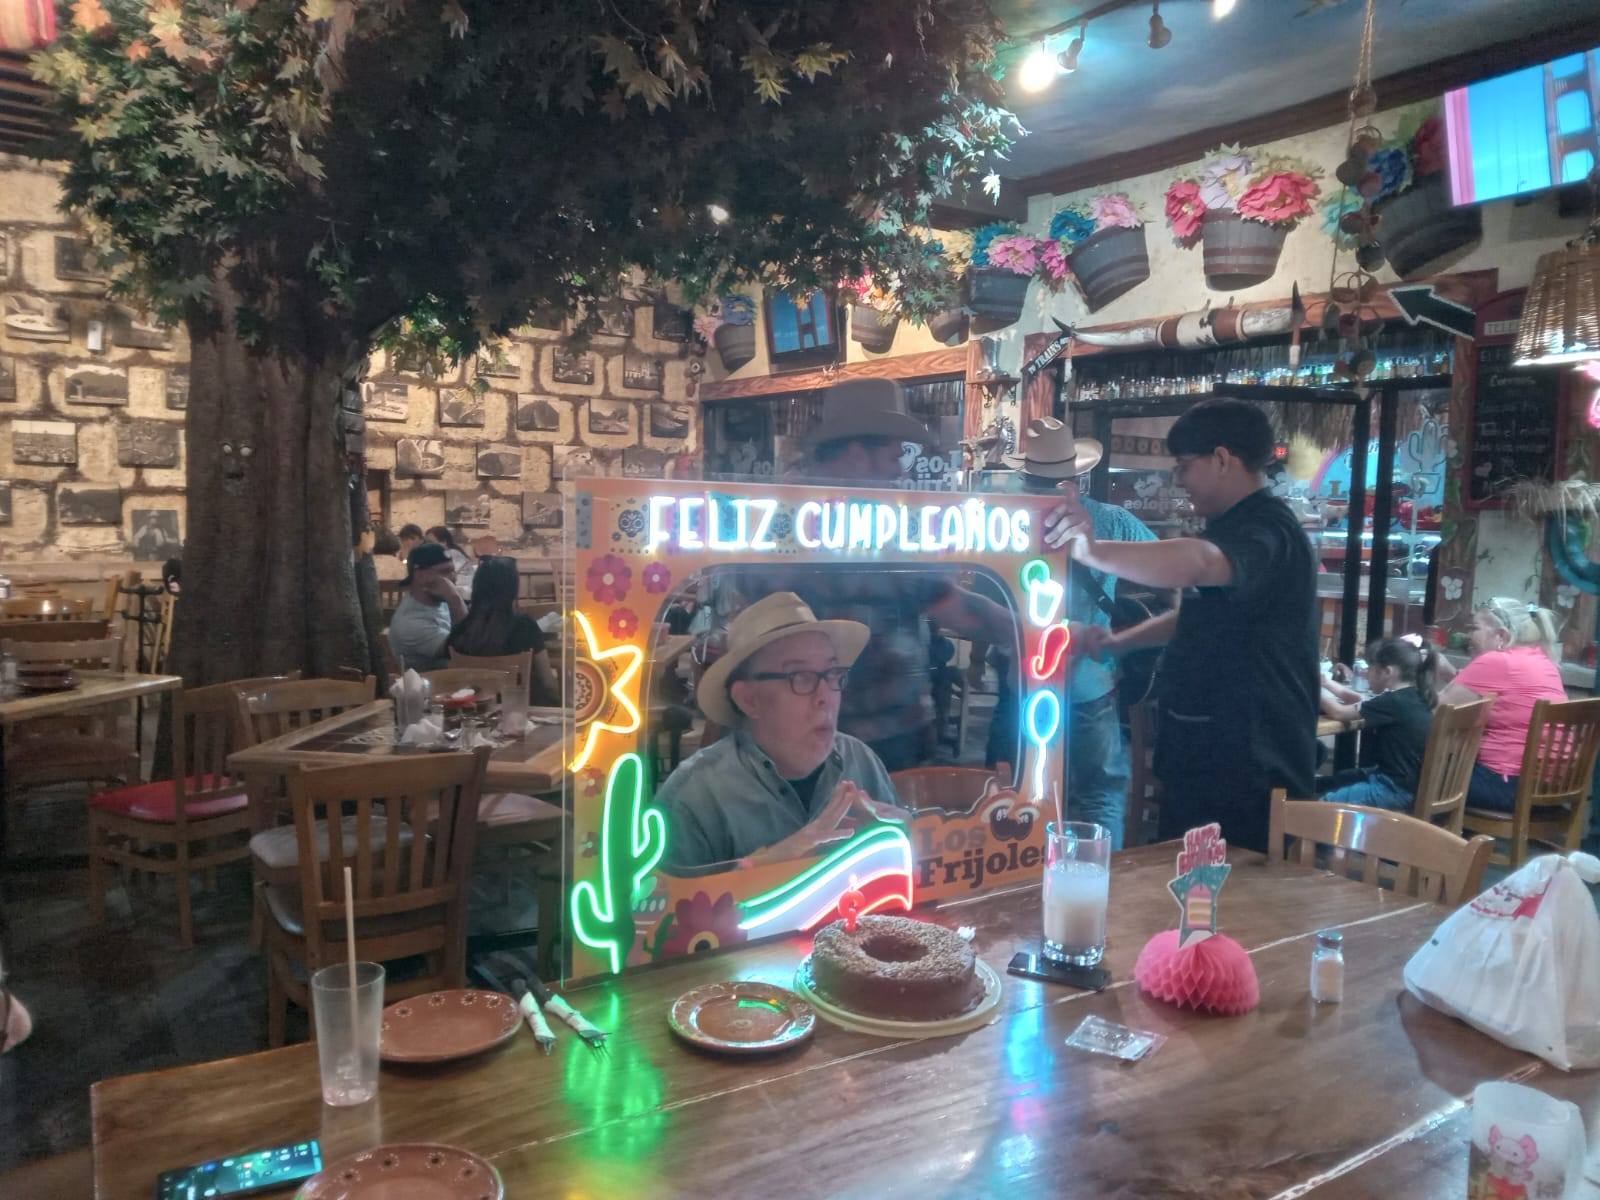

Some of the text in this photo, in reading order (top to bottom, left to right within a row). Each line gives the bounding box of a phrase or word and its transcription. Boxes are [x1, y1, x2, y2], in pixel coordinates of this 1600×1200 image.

[1035, 340, 1062, 369] TRAINS
[646, 496, 1030, 553] FELIZ CUMPLEAÑOS
[918, 826, 988, 855] Los
